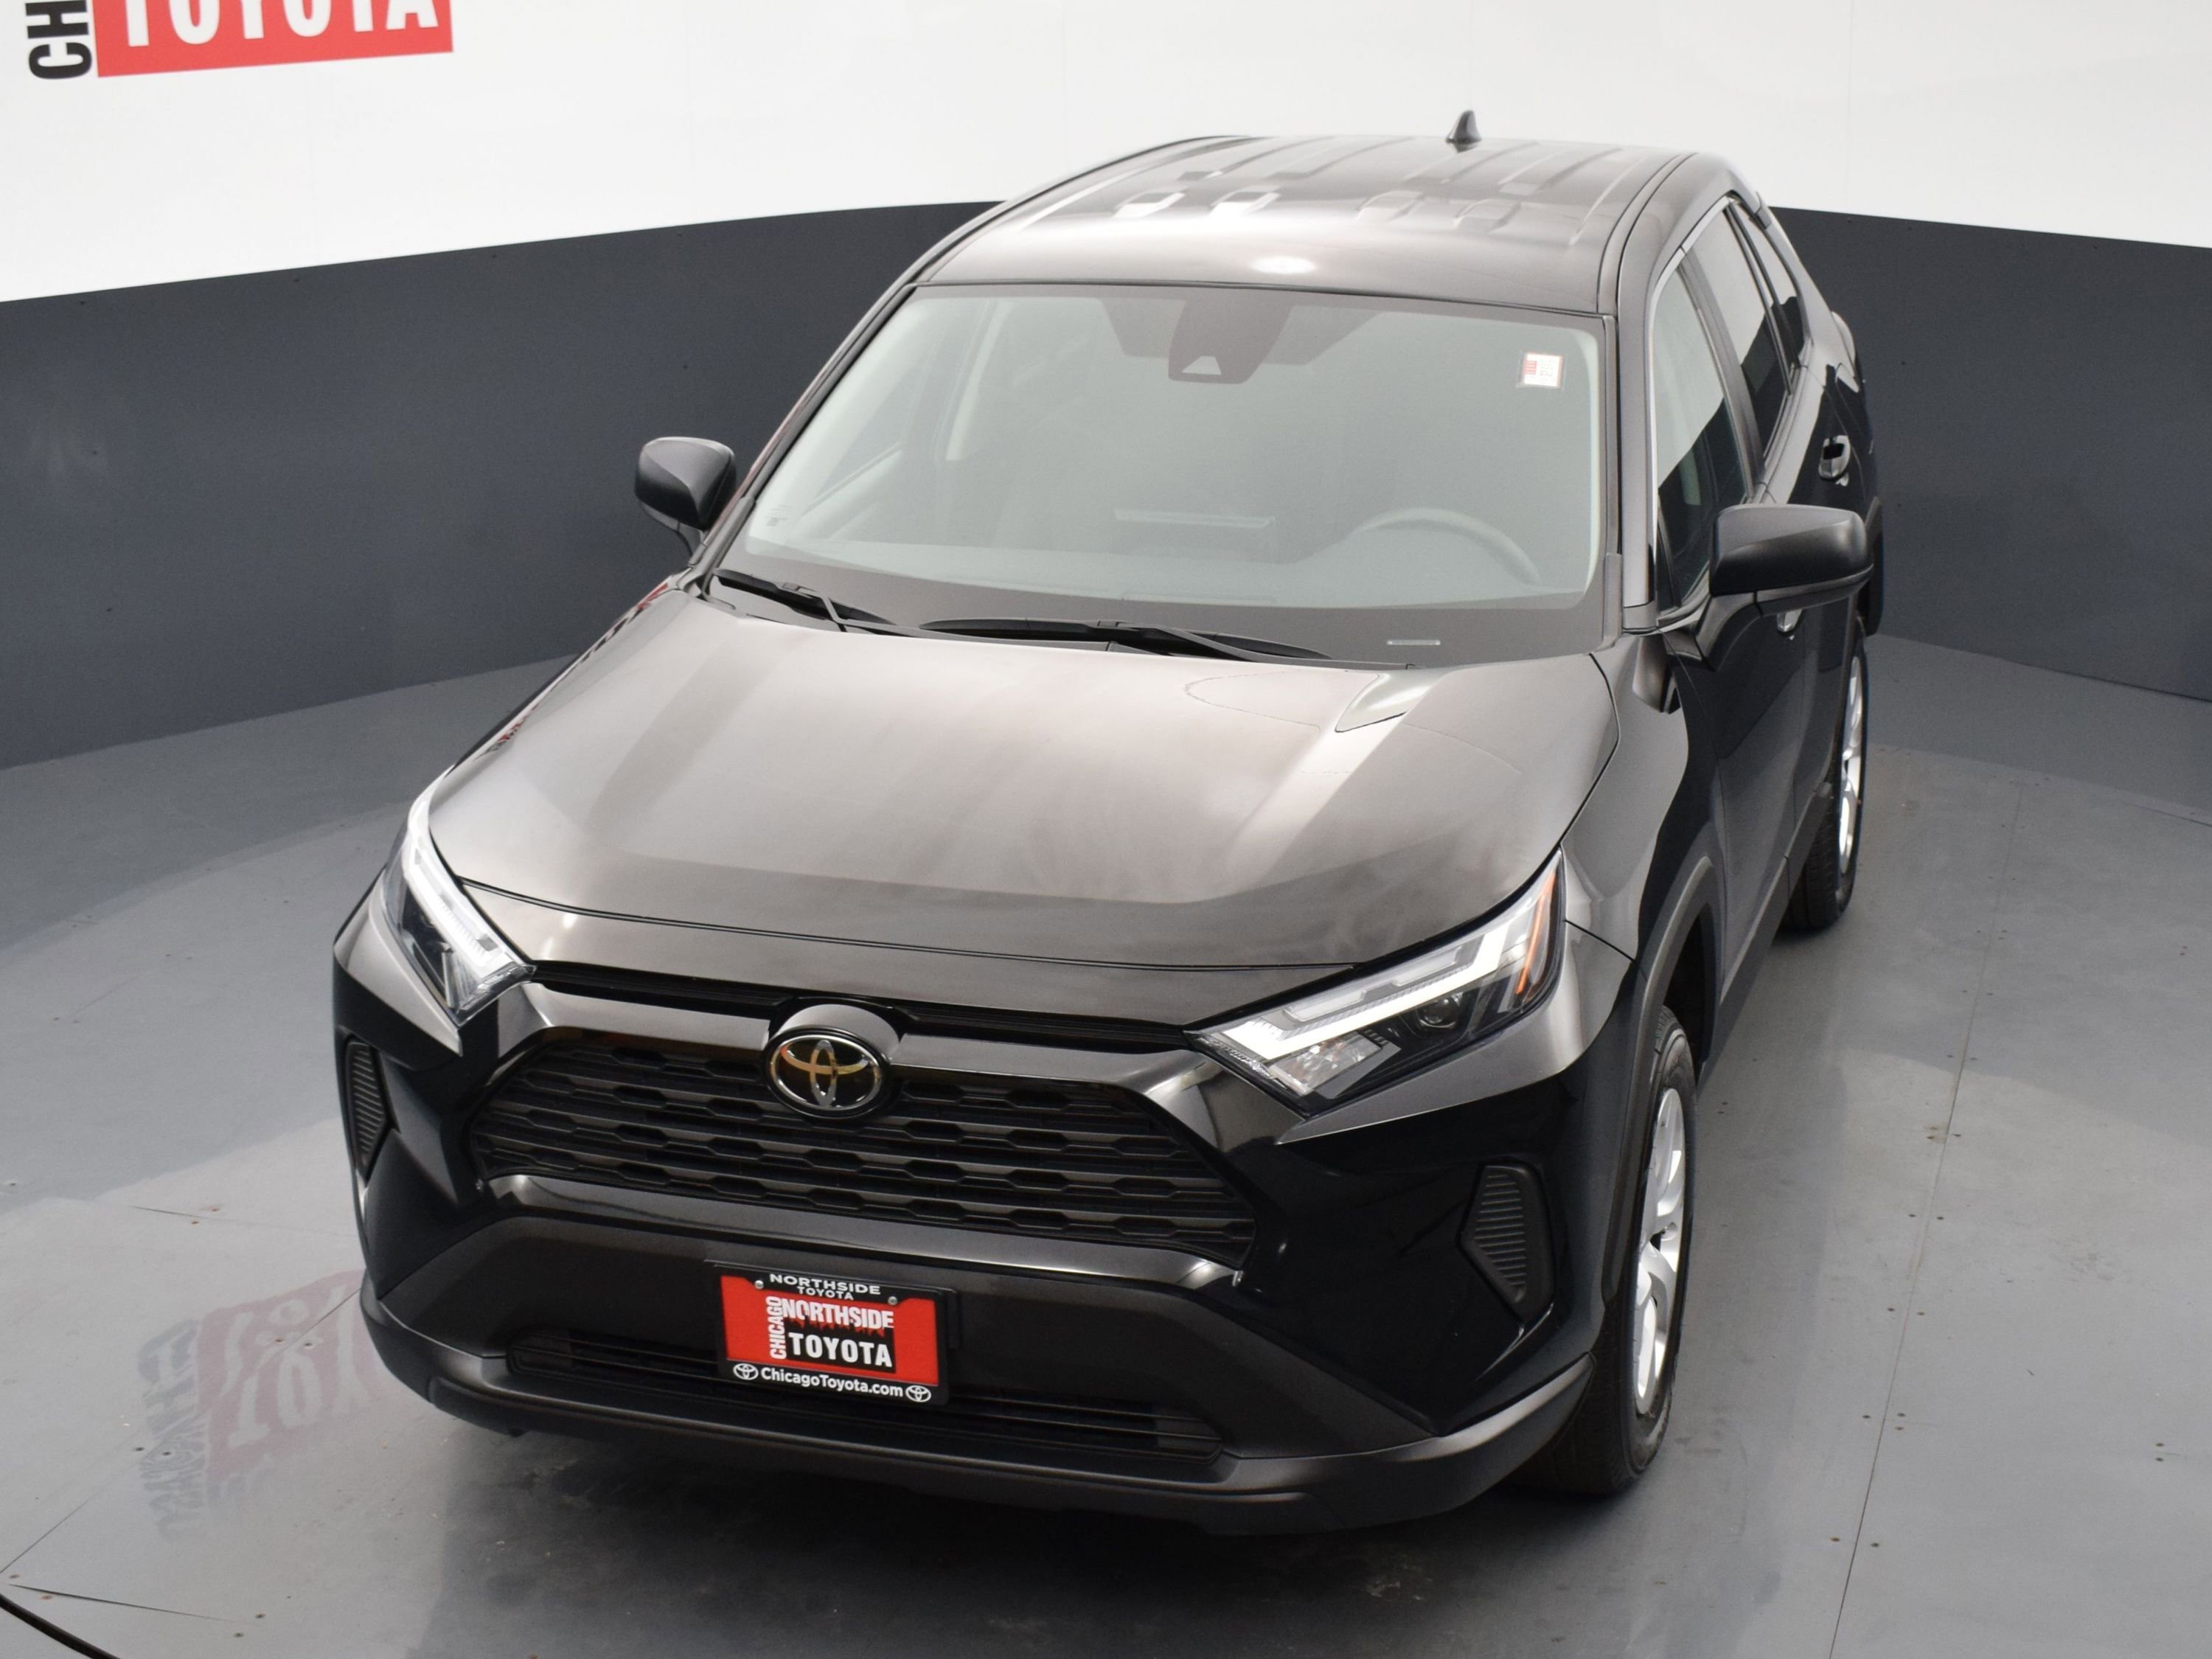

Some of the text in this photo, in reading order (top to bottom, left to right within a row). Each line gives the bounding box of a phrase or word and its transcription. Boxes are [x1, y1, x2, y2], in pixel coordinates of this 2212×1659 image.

[769, 1273, 881, 1295] NORTHSIDE
[796, 1286, 854, 1301] TOYOTA
[765, 1295, 787, 1360] CHICAGO
[781, 1298, 894, 1329] NORTHSIDE
[788, 1332, 893, 1368] TOYOTA
[760, 1367, 903, 1397] ChicagoToyota.com
